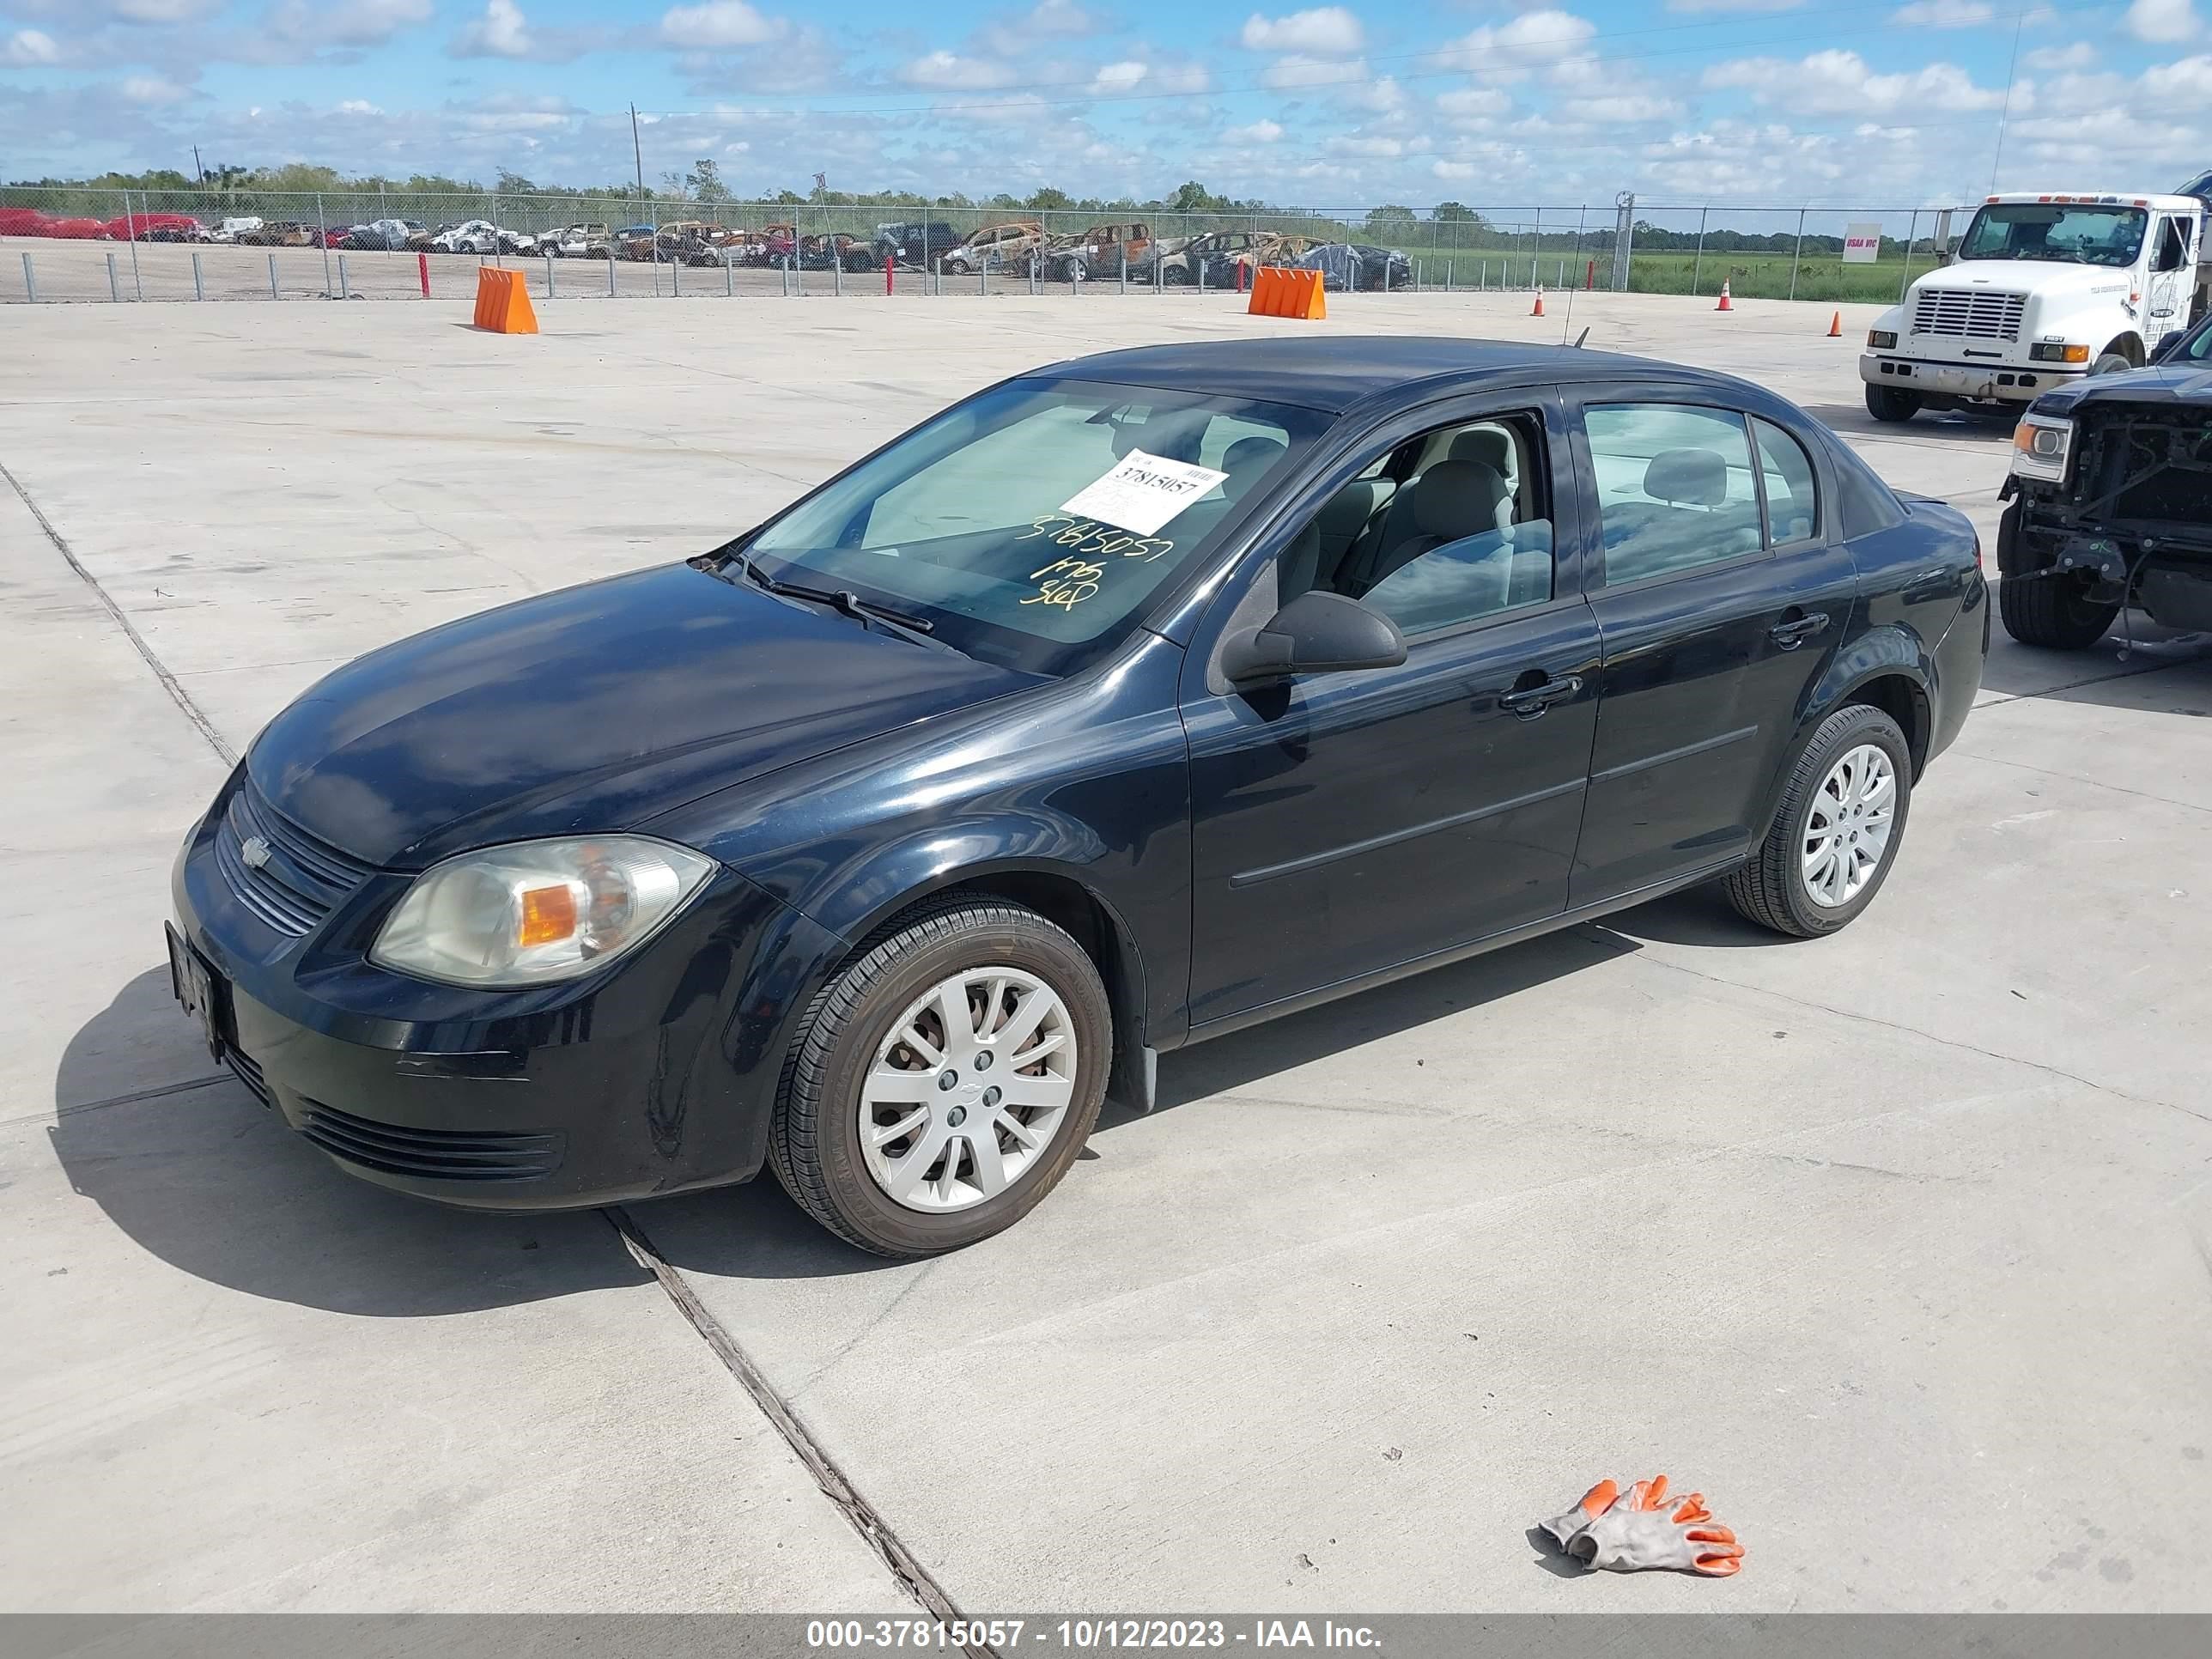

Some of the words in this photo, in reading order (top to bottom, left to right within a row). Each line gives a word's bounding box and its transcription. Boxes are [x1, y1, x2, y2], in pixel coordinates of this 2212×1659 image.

[1847, 239, 1863, 247] USAA
[1115, 467, 1200, 495] 37815057
[1013, 514, 1174, 563] 37815057
